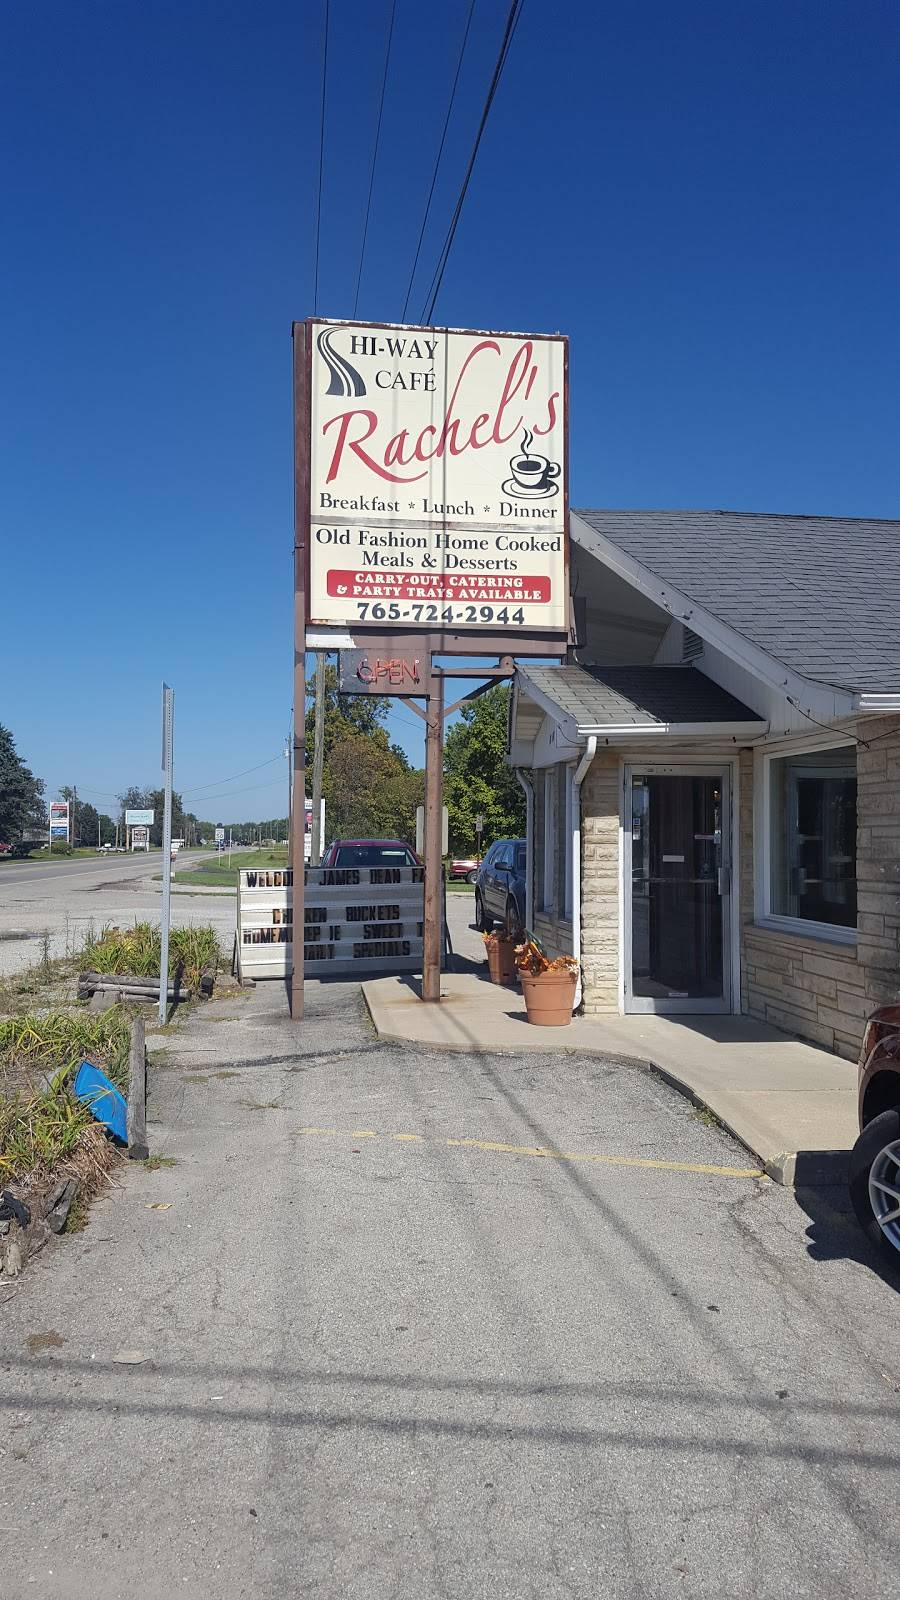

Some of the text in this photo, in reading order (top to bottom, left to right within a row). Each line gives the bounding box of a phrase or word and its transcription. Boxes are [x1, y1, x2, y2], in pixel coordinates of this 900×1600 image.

[350, 335, 438, 359] HI-WAY
[375, 369, 437, 392] CAFÉ
[322, 340, 560, 485] Rachel's
[320, 493, 558, 519] Breakfast Lunch Dinner
[316, 528, 562, 552] Old Fashion Home Cooked
[362, 550, 518, 571] Meals & Desserts
[355, 573, 524, 588] CARRY-OUT, CATERING
[336, 584, 542, 600] & PARTY TRAYS AVAILABLE
[357, 603, 525, 624] 765-724-2944
[354, 658, 420, 686] OPEN
[319, 869, 360, 886] JAMES
[369, 868, 401, 884] DEAN
[272, 904, 400, 924] CHIKEN BUCKETS
